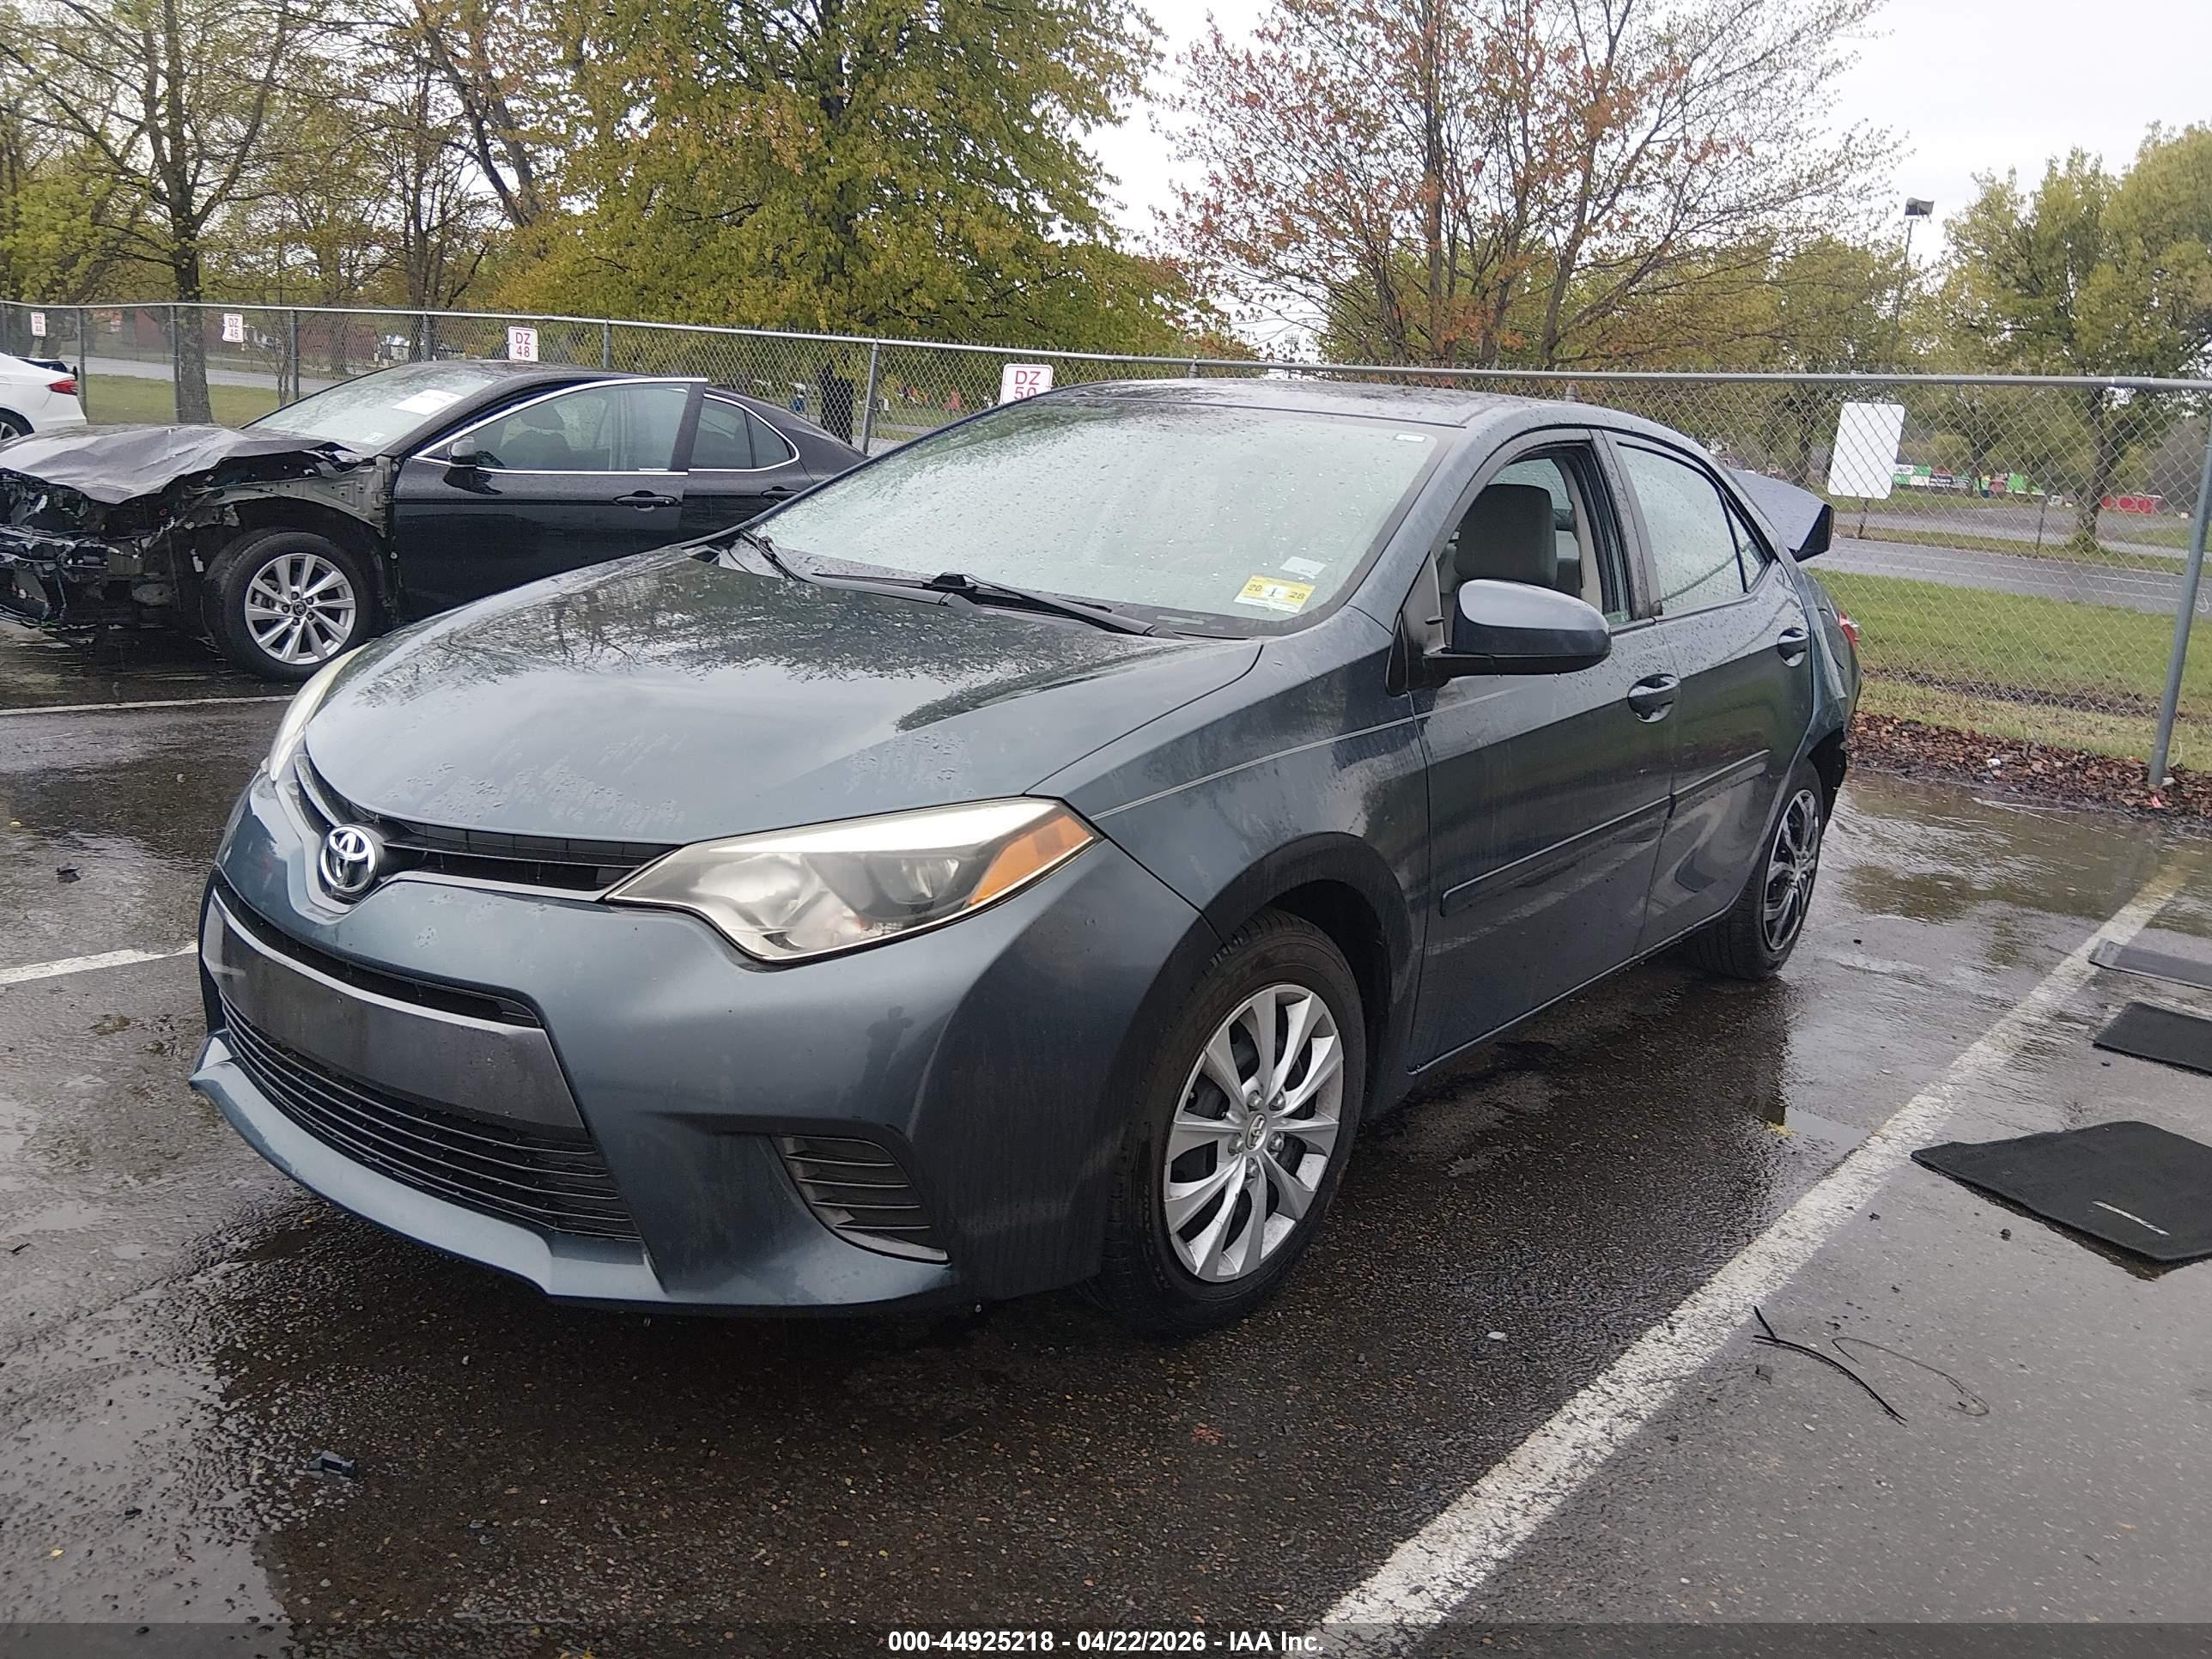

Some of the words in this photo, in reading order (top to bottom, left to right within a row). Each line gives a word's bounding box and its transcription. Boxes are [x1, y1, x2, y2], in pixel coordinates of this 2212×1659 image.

[228, 318, 239, 327] DZ
[515, 332, 531, 344] DZ
[516, 345, 530, 357] 48
[1015, 370, 1042, 385] DZ
[1014, 386, 1037, 399] 50
